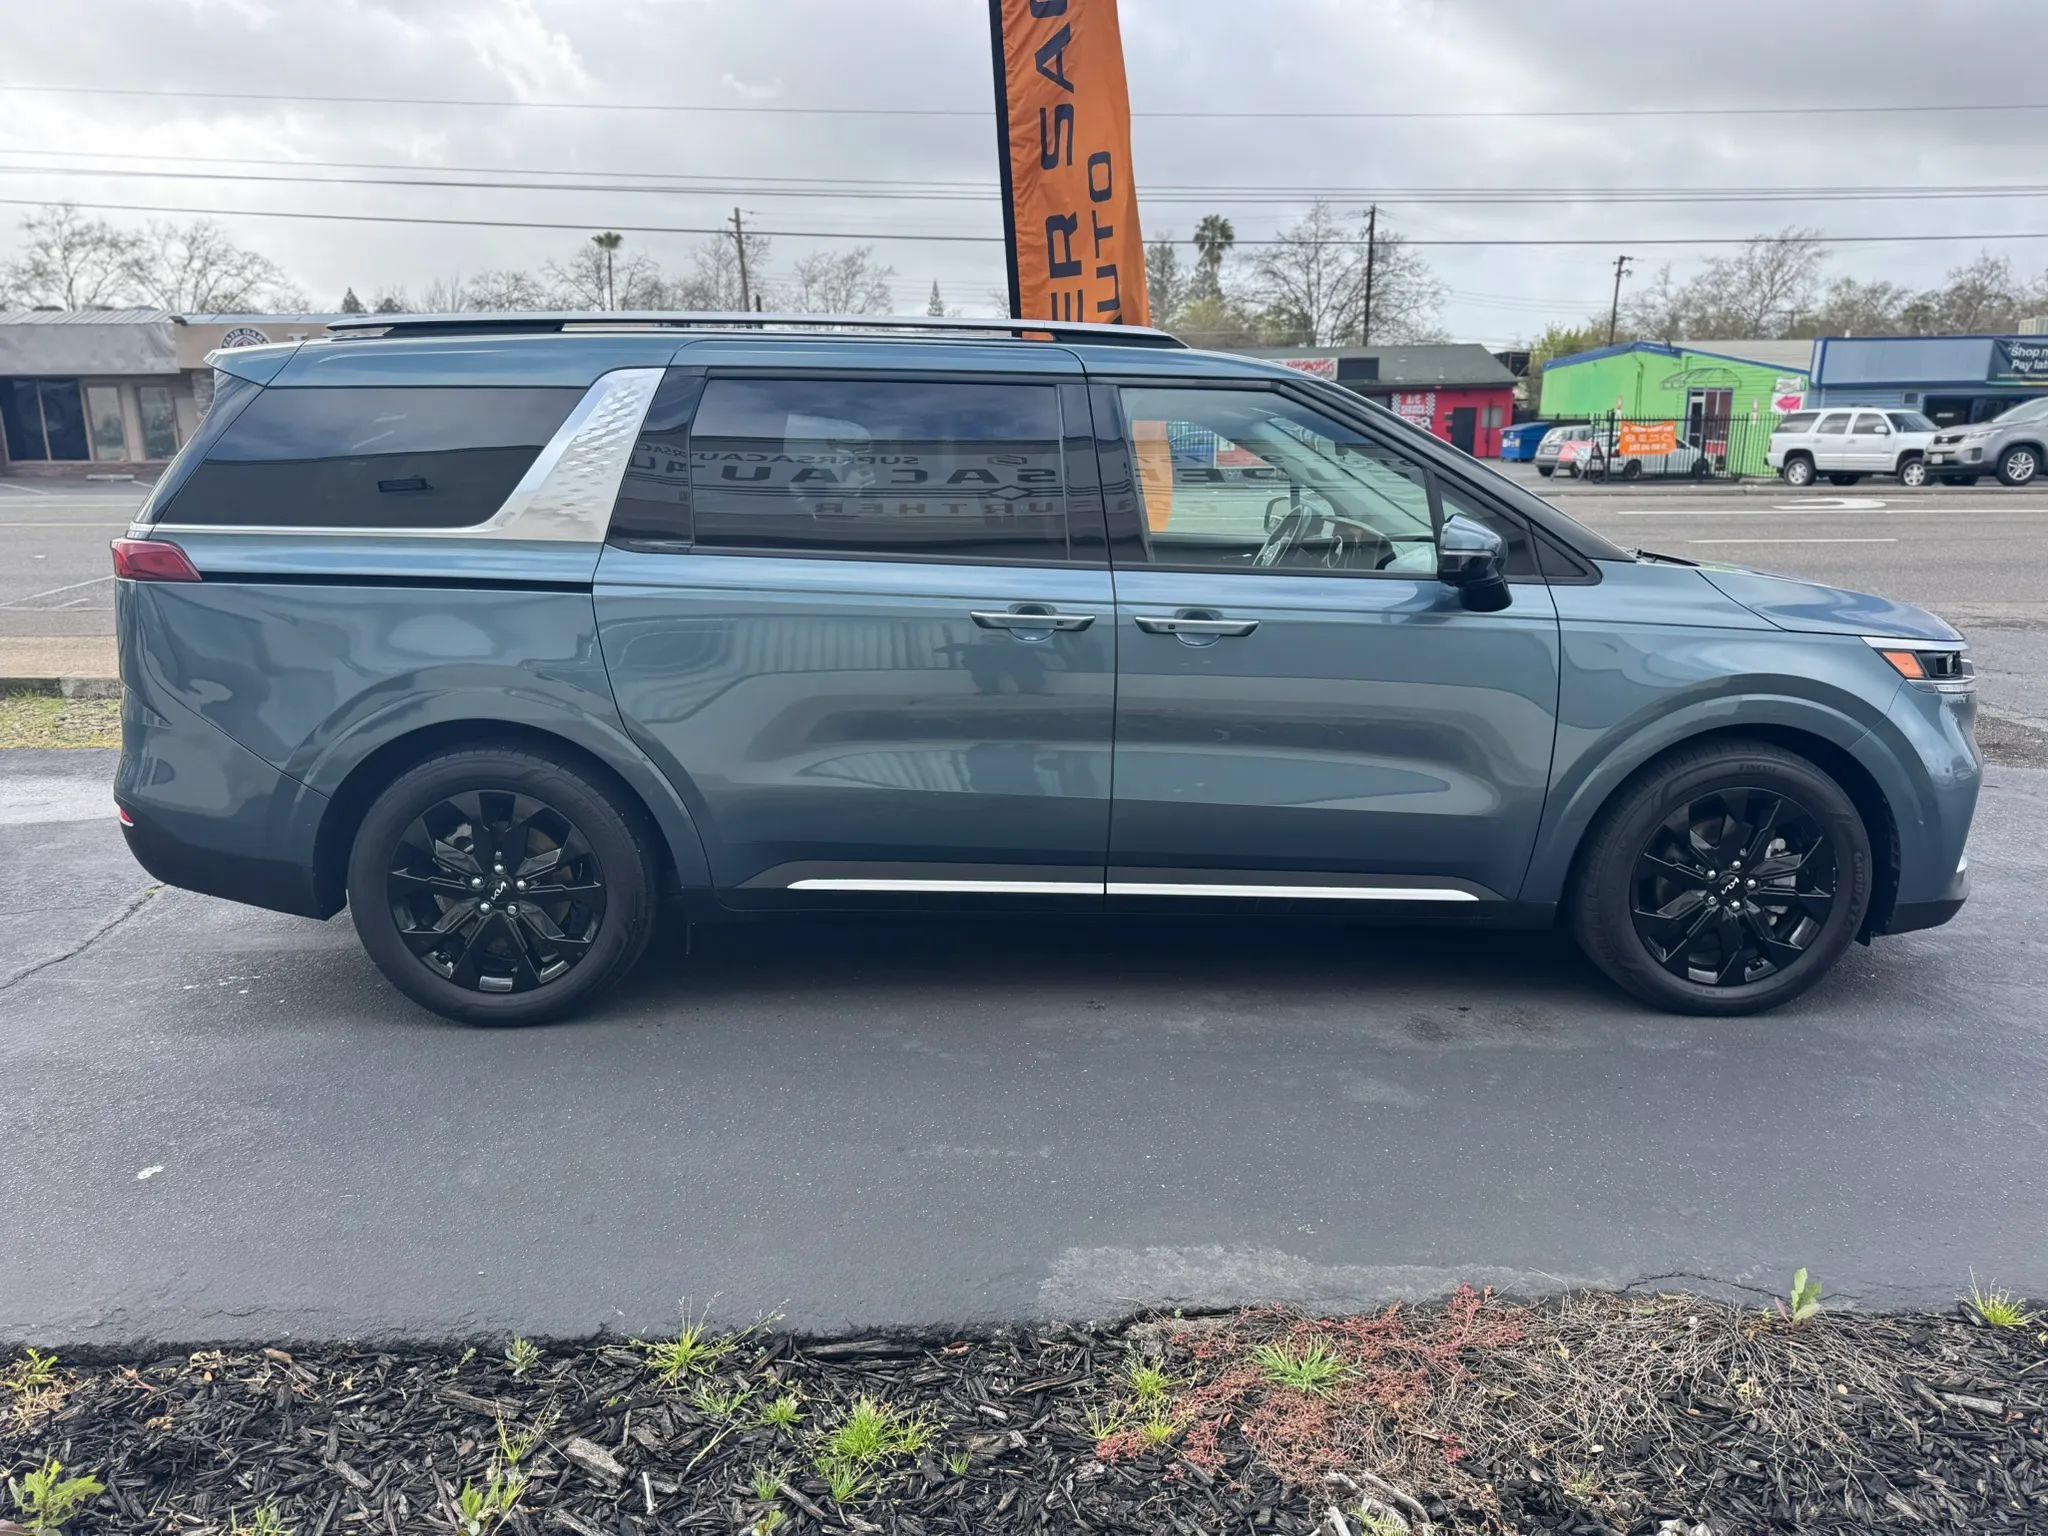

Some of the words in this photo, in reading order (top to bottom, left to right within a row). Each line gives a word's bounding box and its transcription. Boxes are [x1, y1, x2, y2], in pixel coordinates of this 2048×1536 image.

[1029, 0, 1074, 171] SA
[1088, 151, 1124, 325] UTO
[2010, 346, 2040, 358] Shop
[2011, 359, 2032, 372] Pay
